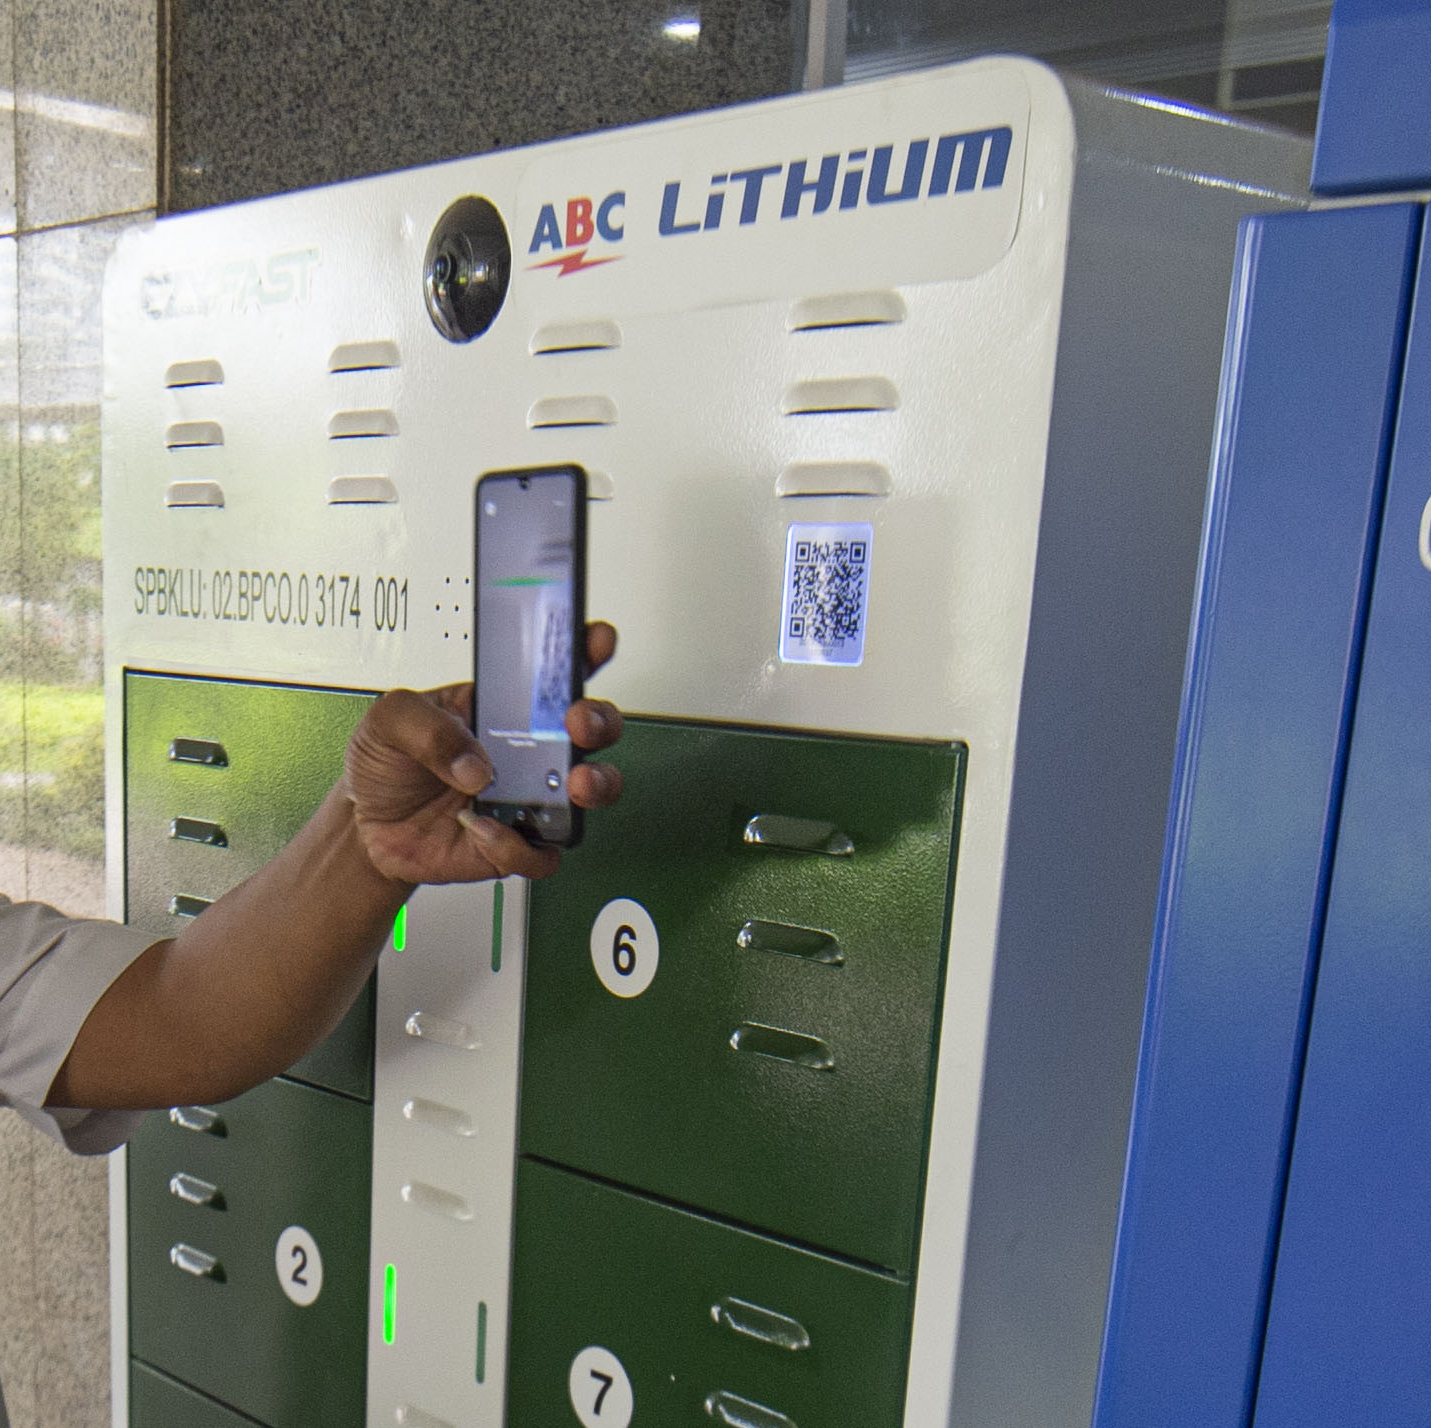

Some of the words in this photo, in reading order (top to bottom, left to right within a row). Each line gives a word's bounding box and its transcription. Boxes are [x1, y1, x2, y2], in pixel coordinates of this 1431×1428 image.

[528, 191, 626, 254] ABC
[134, 566, 207, 620] SPBKLU:
[374, 576, 409, 632] 001
[613, 924, 637, 976] 6
[291, 1246, 308, 1285] 2
[589, 1371, 613, 1415] 7
